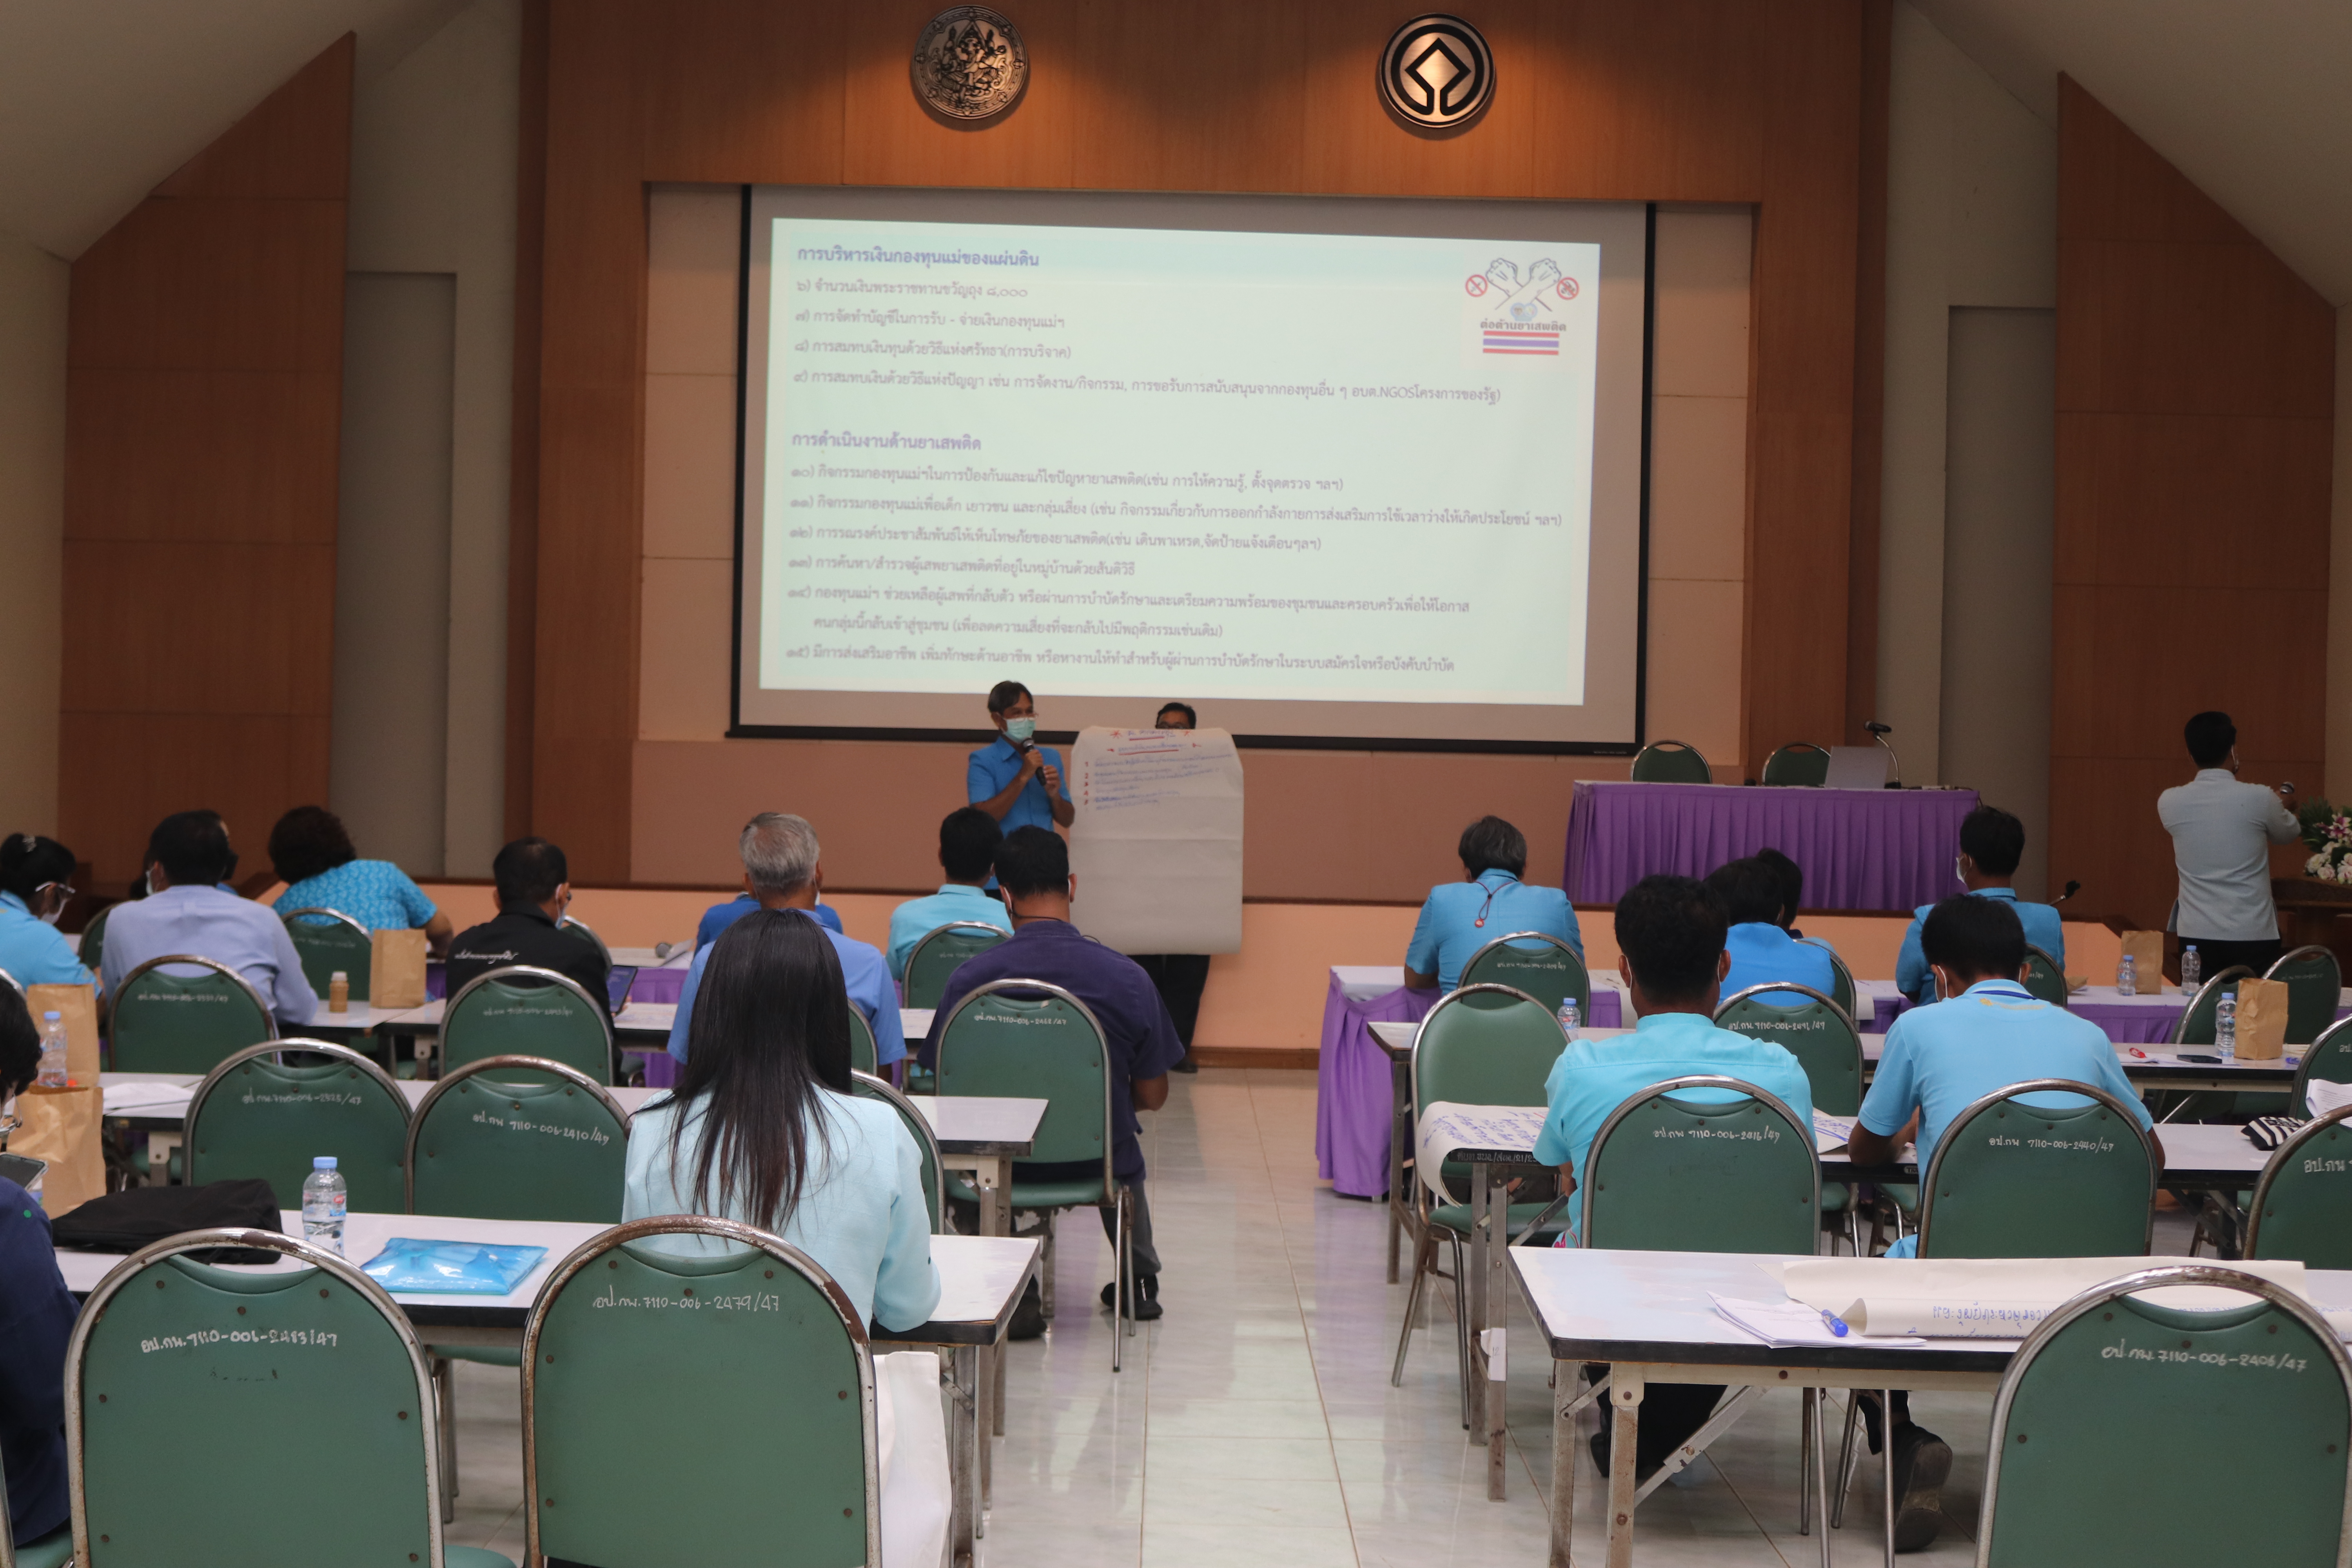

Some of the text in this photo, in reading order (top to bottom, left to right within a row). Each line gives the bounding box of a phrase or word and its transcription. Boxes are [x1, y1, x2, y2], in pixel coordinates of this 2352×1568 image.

[1480, 318, 1566, 331] ต่อต้านยาเสพติด
[1251, 470, 1311, 493] ตั้งจุดตรวจ
[966, 502, 1009, 512] เยาวชน
[815, 585, 880, 603] กองทุนแม่ฯ
